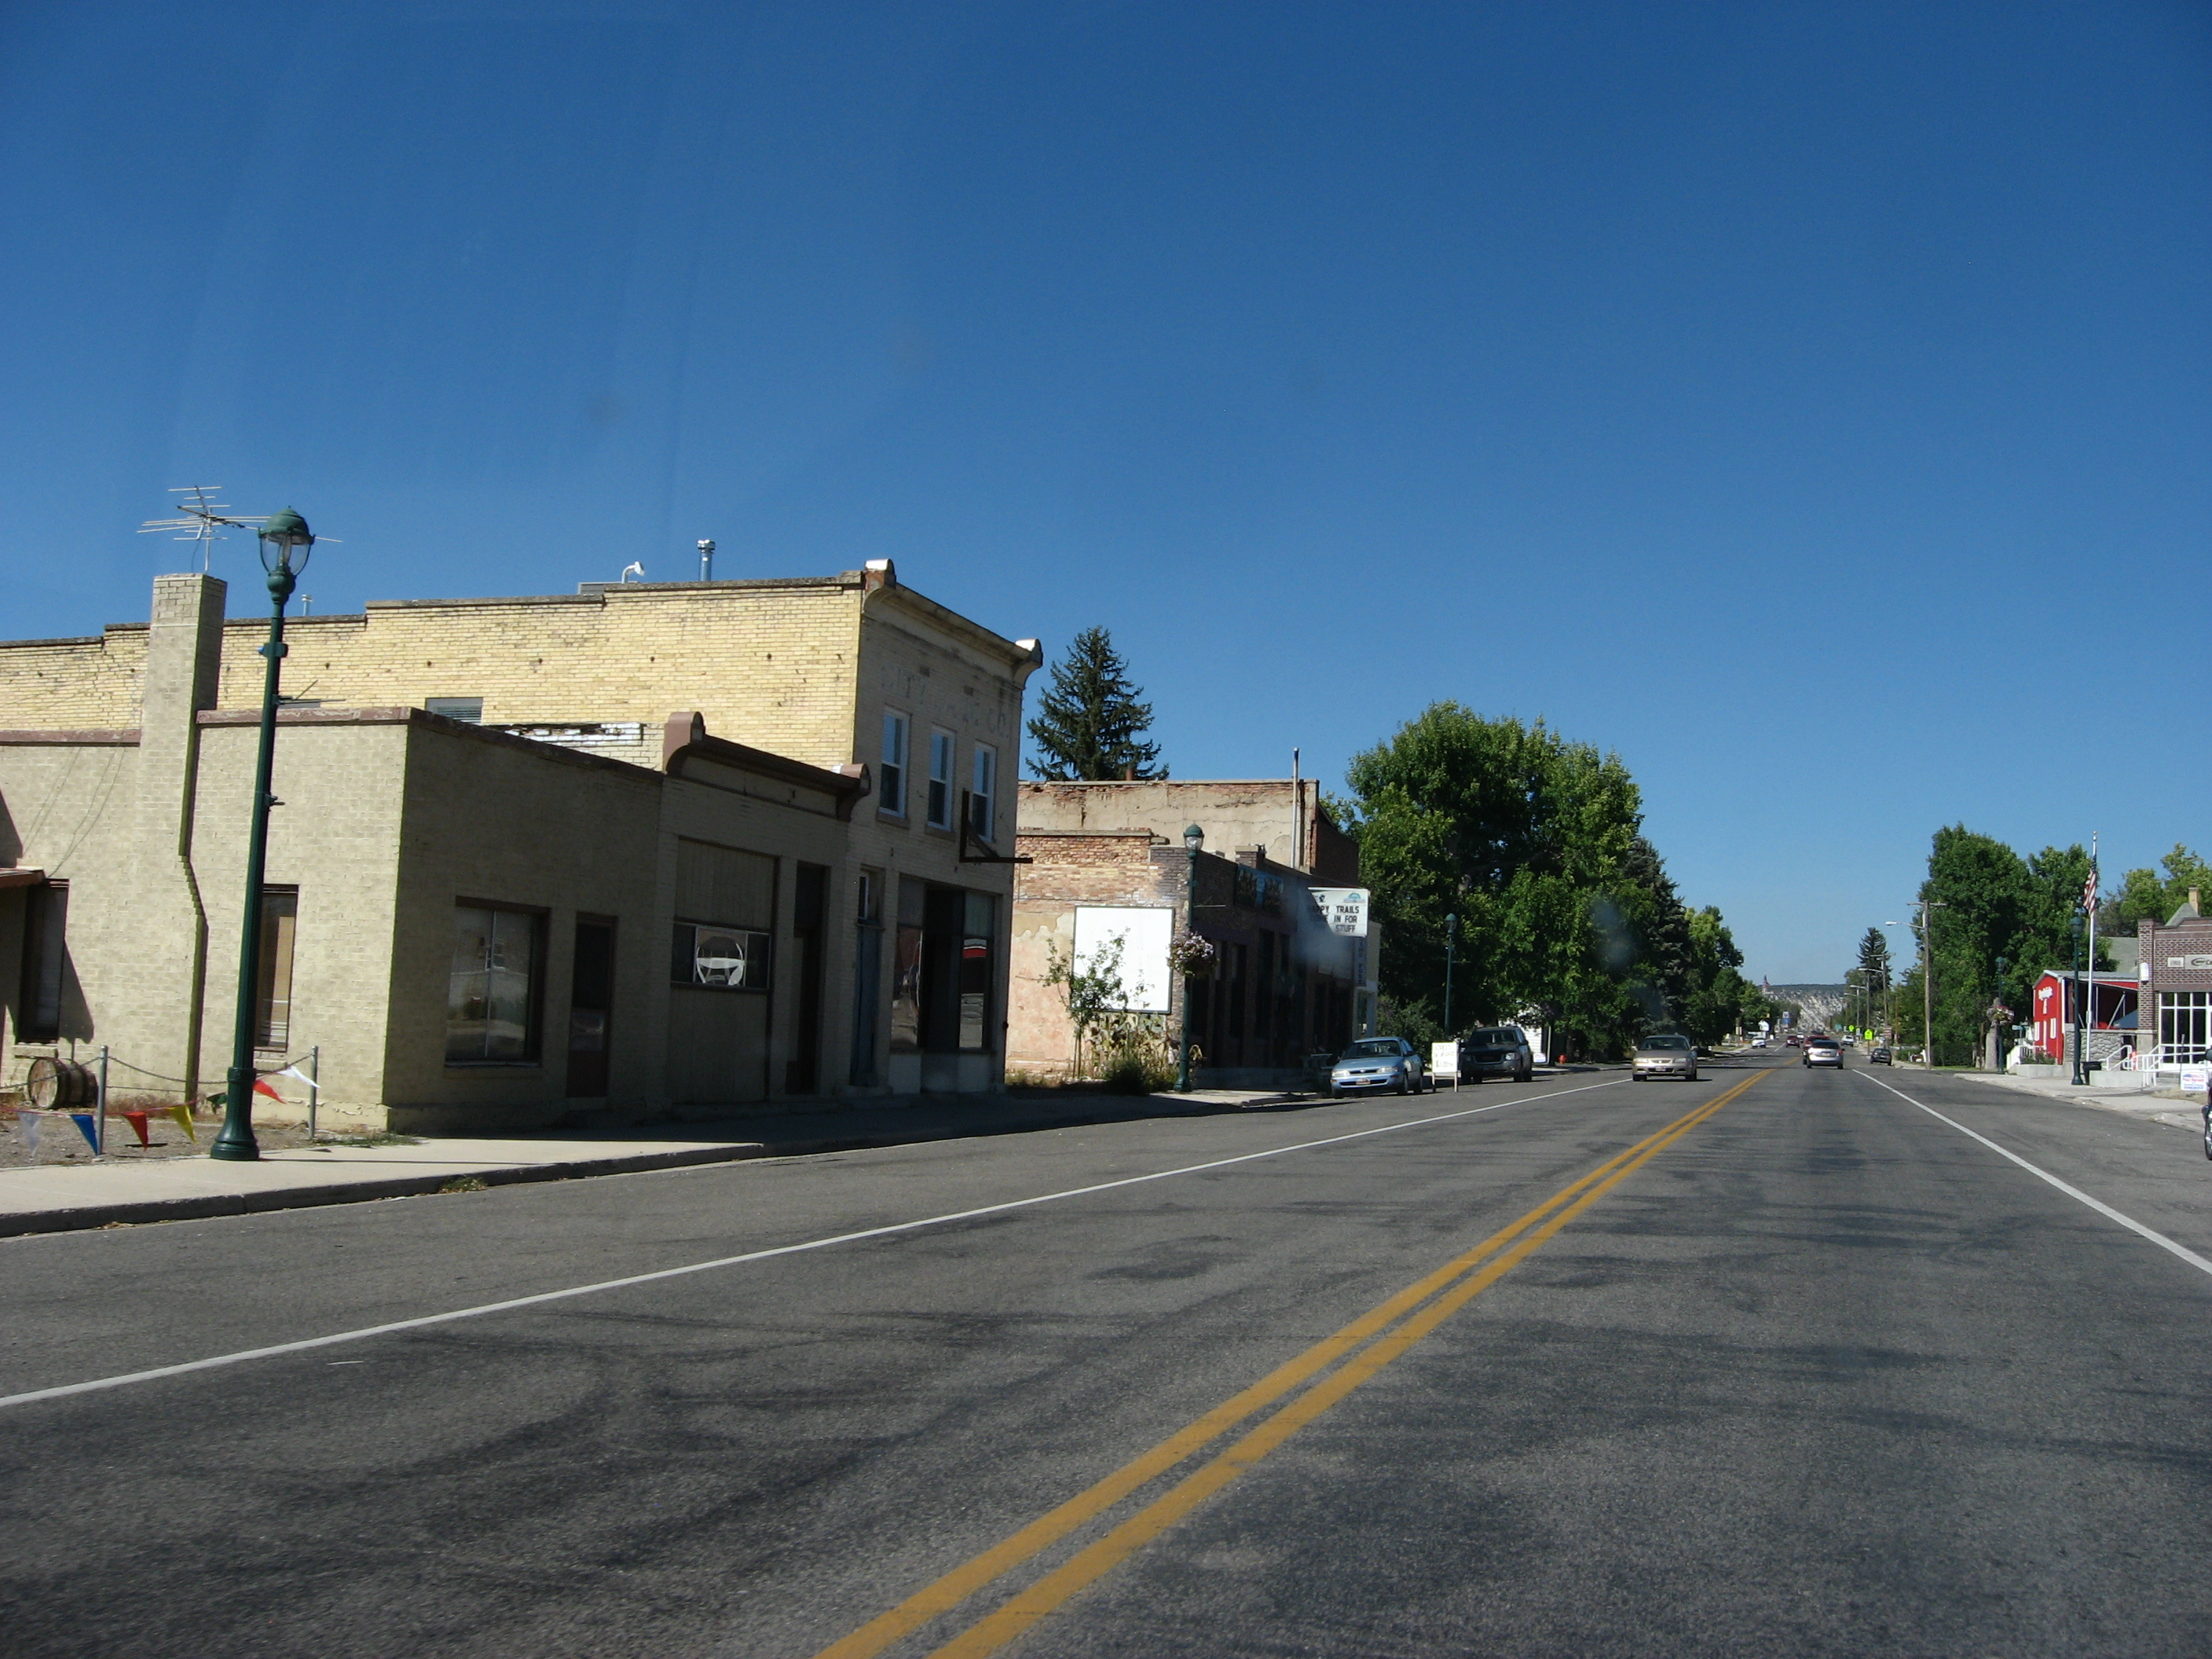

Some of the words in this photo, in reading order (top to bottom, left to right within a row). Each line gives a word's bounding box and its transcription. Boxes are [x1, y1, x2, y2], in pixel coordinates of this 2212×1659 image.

[1336, 905, 1360, 914] TRAILS
[1334, 914, 1342, 923] IN
[1344, 914, 1358, 924] FOR
[1335, 924, 1356, 933] STUFF
